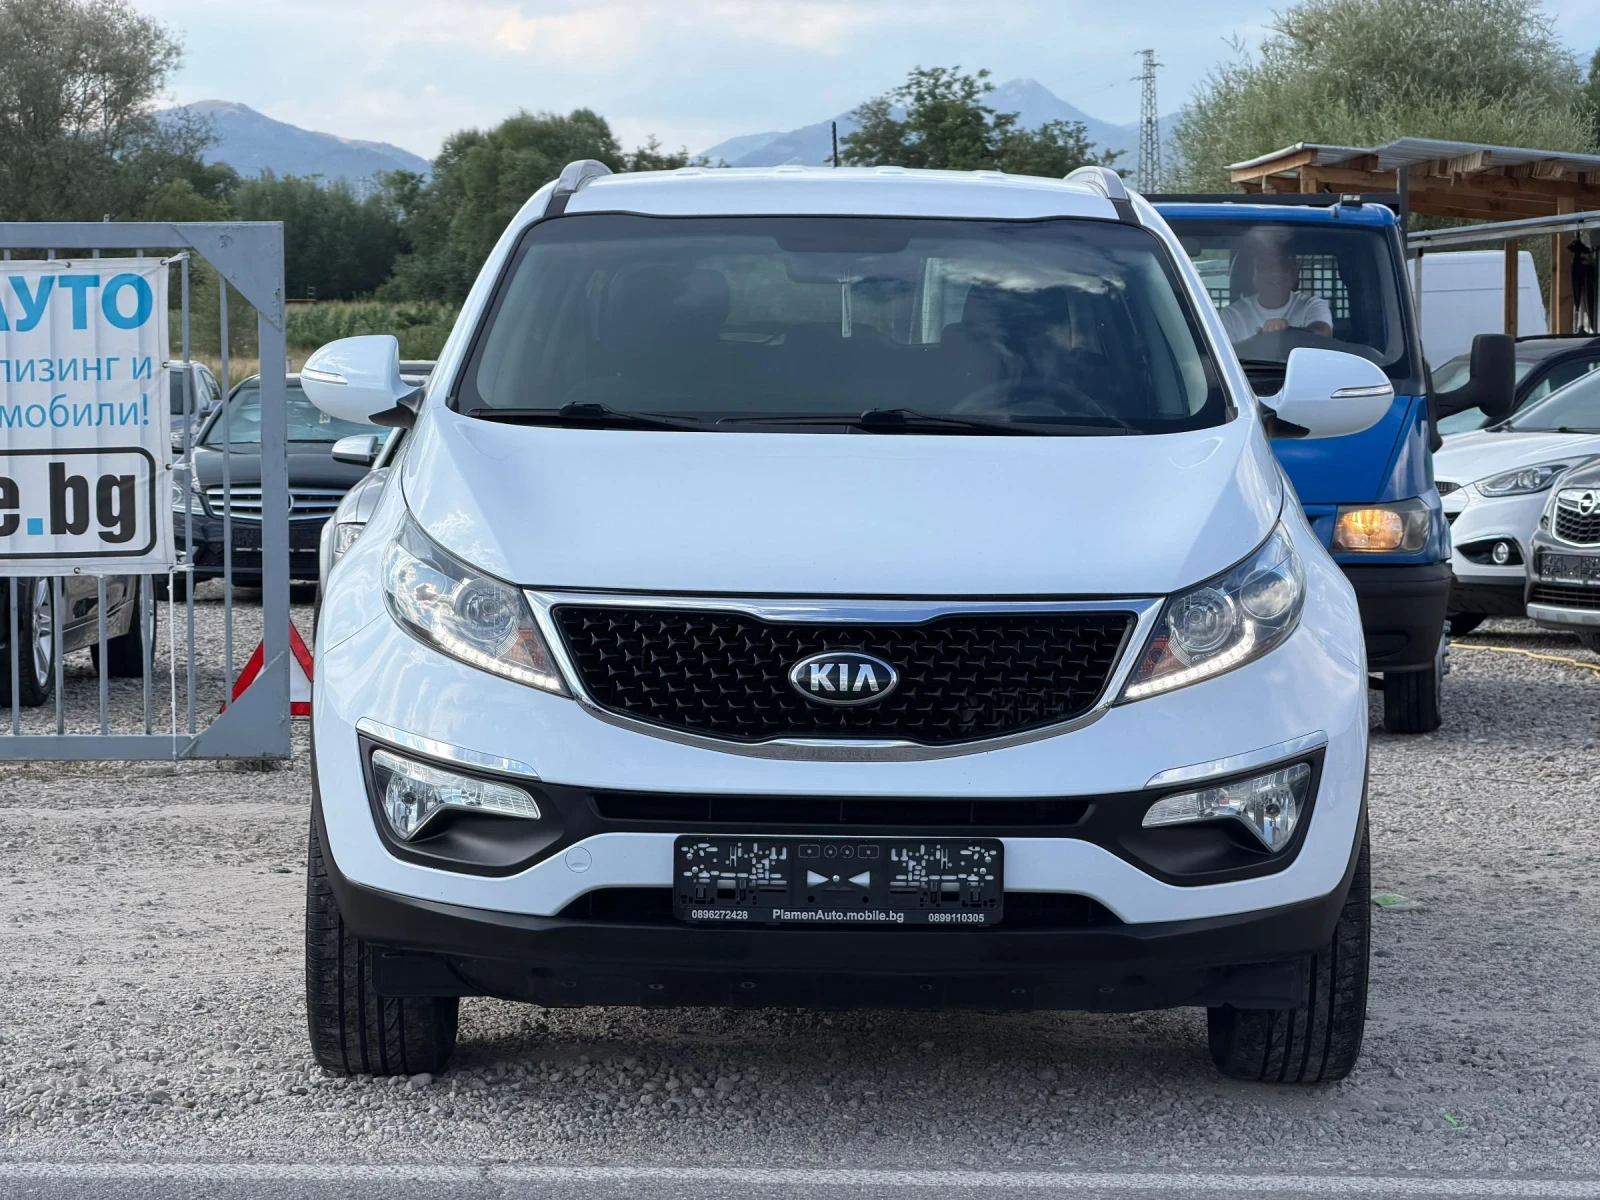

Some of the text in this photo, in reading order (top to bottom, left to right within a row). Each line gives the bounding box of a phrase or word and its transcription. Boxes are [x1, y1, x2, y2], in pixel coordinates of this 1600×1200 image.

[0, 273, 153, 332] УТО
[132, 356, 152, 380] и
[0, 393, 149, 428] мобили!
[809, 663, 880, 692] KIA
[691, 909, 749, 920] 0896272428
[772, 908, 905, 923] PlamenAuto.mobile.bg
[928, 912, 985, 923] 0899110305
